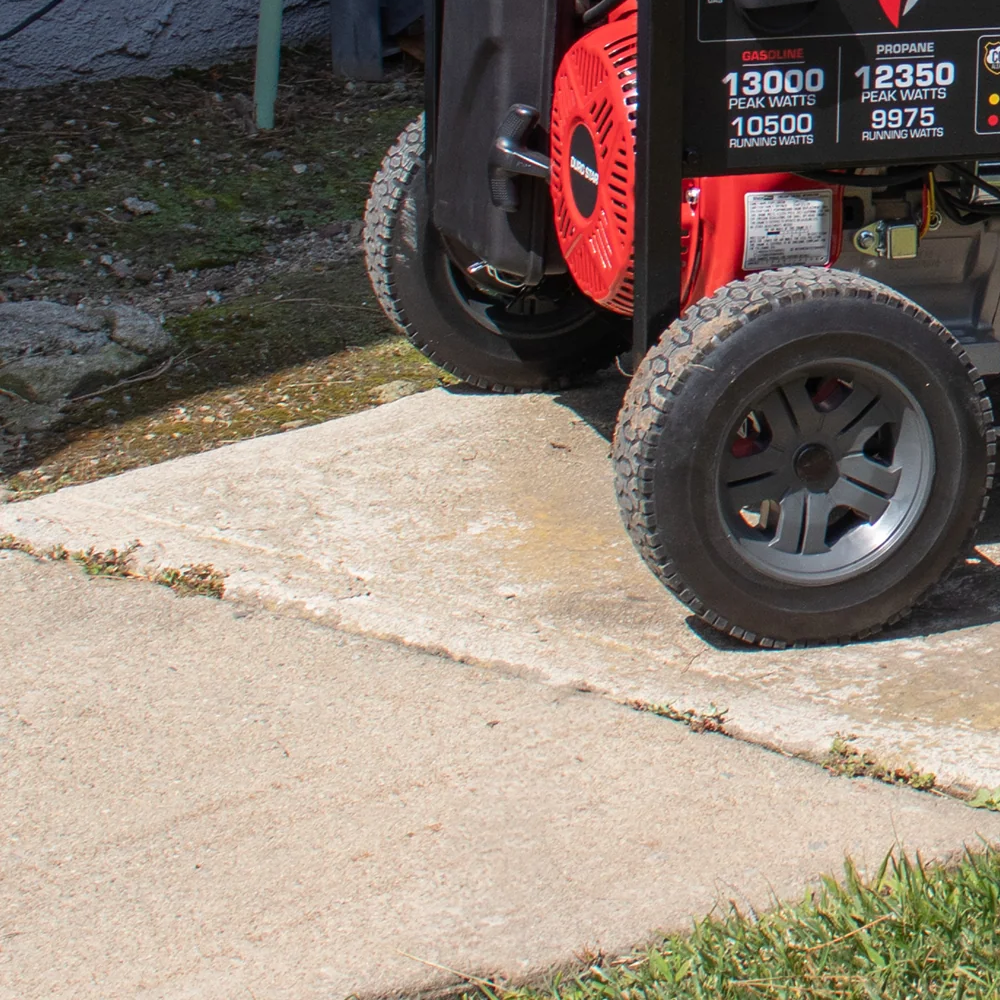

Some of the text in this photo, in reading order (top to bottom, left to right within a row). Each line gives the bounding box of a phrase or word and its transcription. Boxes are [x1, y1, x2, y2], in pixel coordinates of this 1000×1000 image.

[742, 48, 804, 62] GASOLINE
[876, 42, 934, 55] PROPANE
[721, 68, 824, 96] 13000
[854, 62, 956, 90] 12350
[728, 94, 817, 110] PEAK WATTS
[861, 88, 947, 103] PEAK WATTS
[731, 113, 812, 137] 10500
[871, 106, 935, 130] 9975
[729, 134, 814, 148] RUNNING WATTS
[862, 128, 944, 142] RUNNING WATTS
